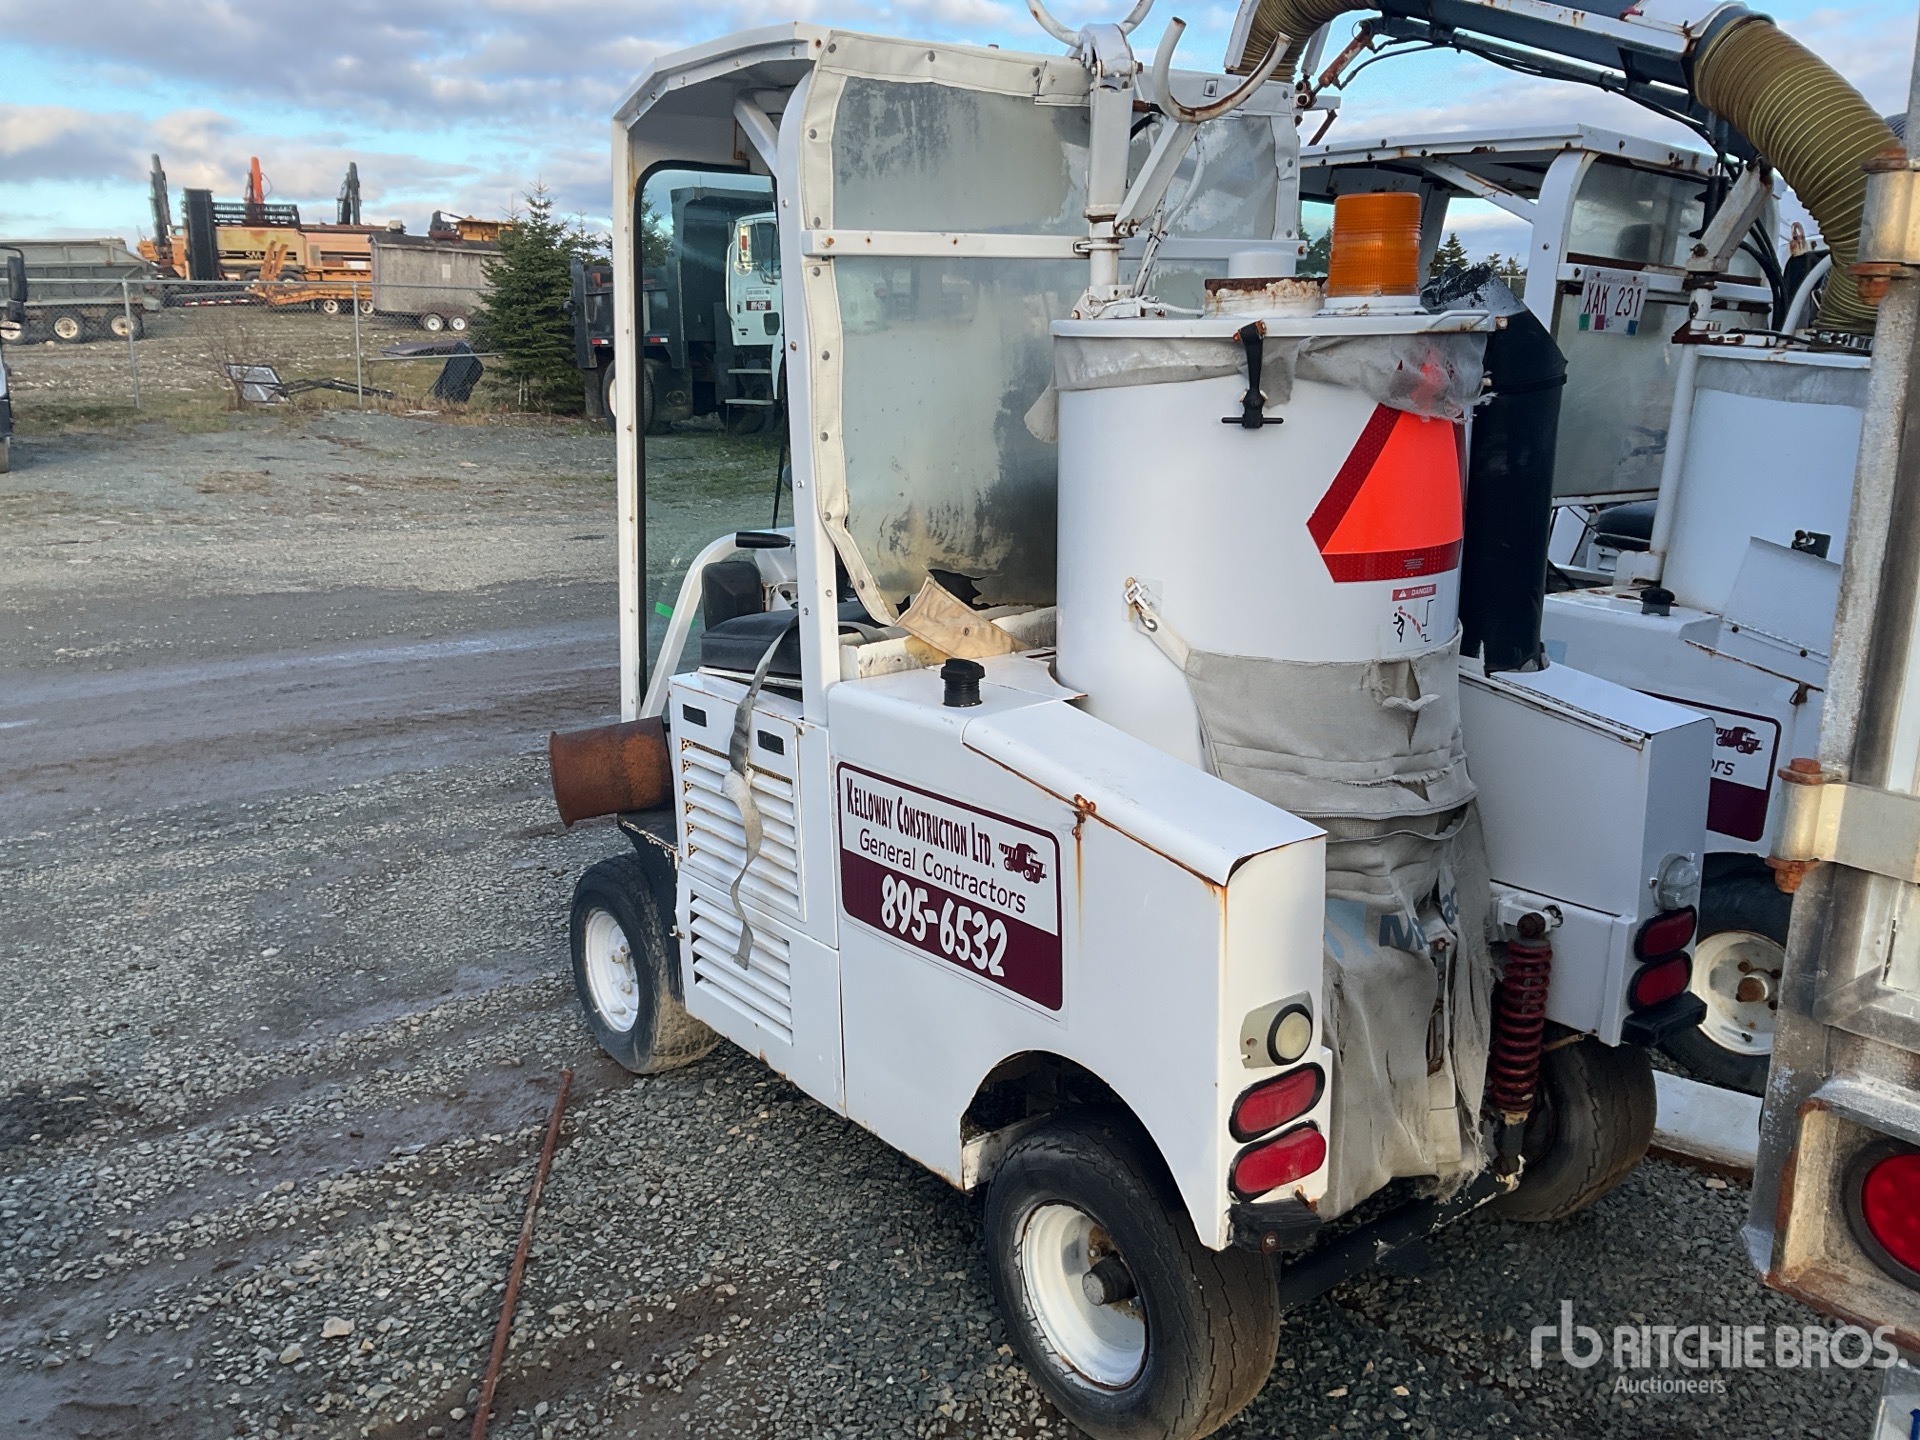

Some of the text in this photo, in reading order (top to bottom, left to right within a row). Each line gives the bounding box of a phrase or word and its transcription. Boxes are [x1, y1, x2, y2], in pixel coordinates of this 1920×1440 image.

[1583, 282, 1642, 318] XAK 231
[1411, 586, 1433, 596] DANGER
[846, 777, 996, 868] KELLOWAY CONSTRUCTION LTD.
[859, 828, 1027, 914] General Contractors
[881, 873, 1008, 978] 895-6532
